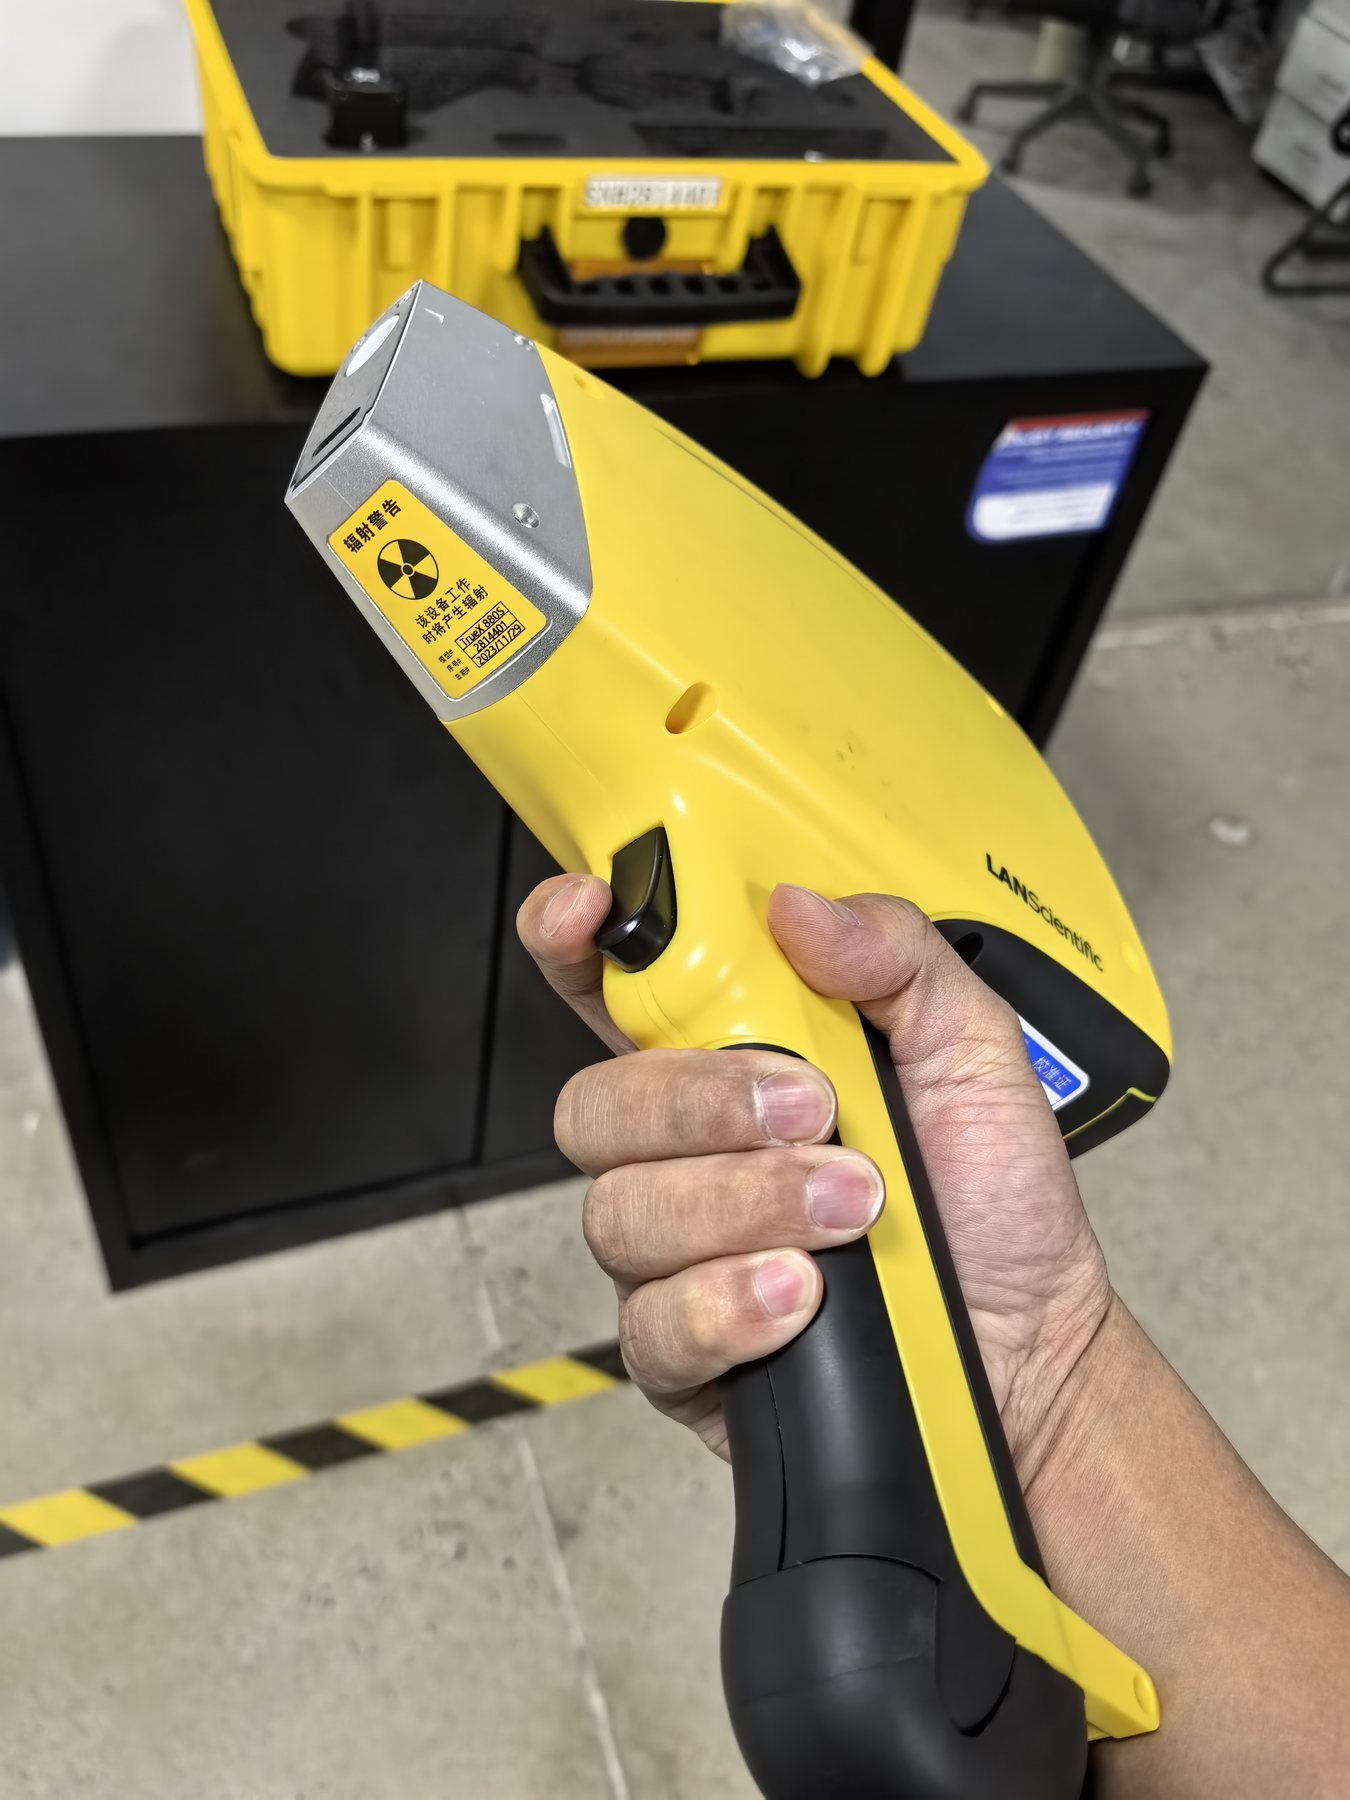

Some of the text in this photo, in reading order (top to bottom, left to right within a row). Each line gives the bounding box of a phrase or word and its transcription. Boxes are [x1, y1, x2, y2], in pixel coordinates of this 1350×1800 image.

[343, 499, 402, 553] 辐射警告
[414, 577, 471, 629] 该设备工作
[421, 584, 489, 645] 时将产生辐射
[459, 606, 506, 647] TrueX 880S
[472, 620, 509, 653] 2814401
[475, 623, 522, 666] 2023/11/29
[985, 852, 1104, 973] LANScientific
[1032, 1055, 1072, 1090] 校准证
